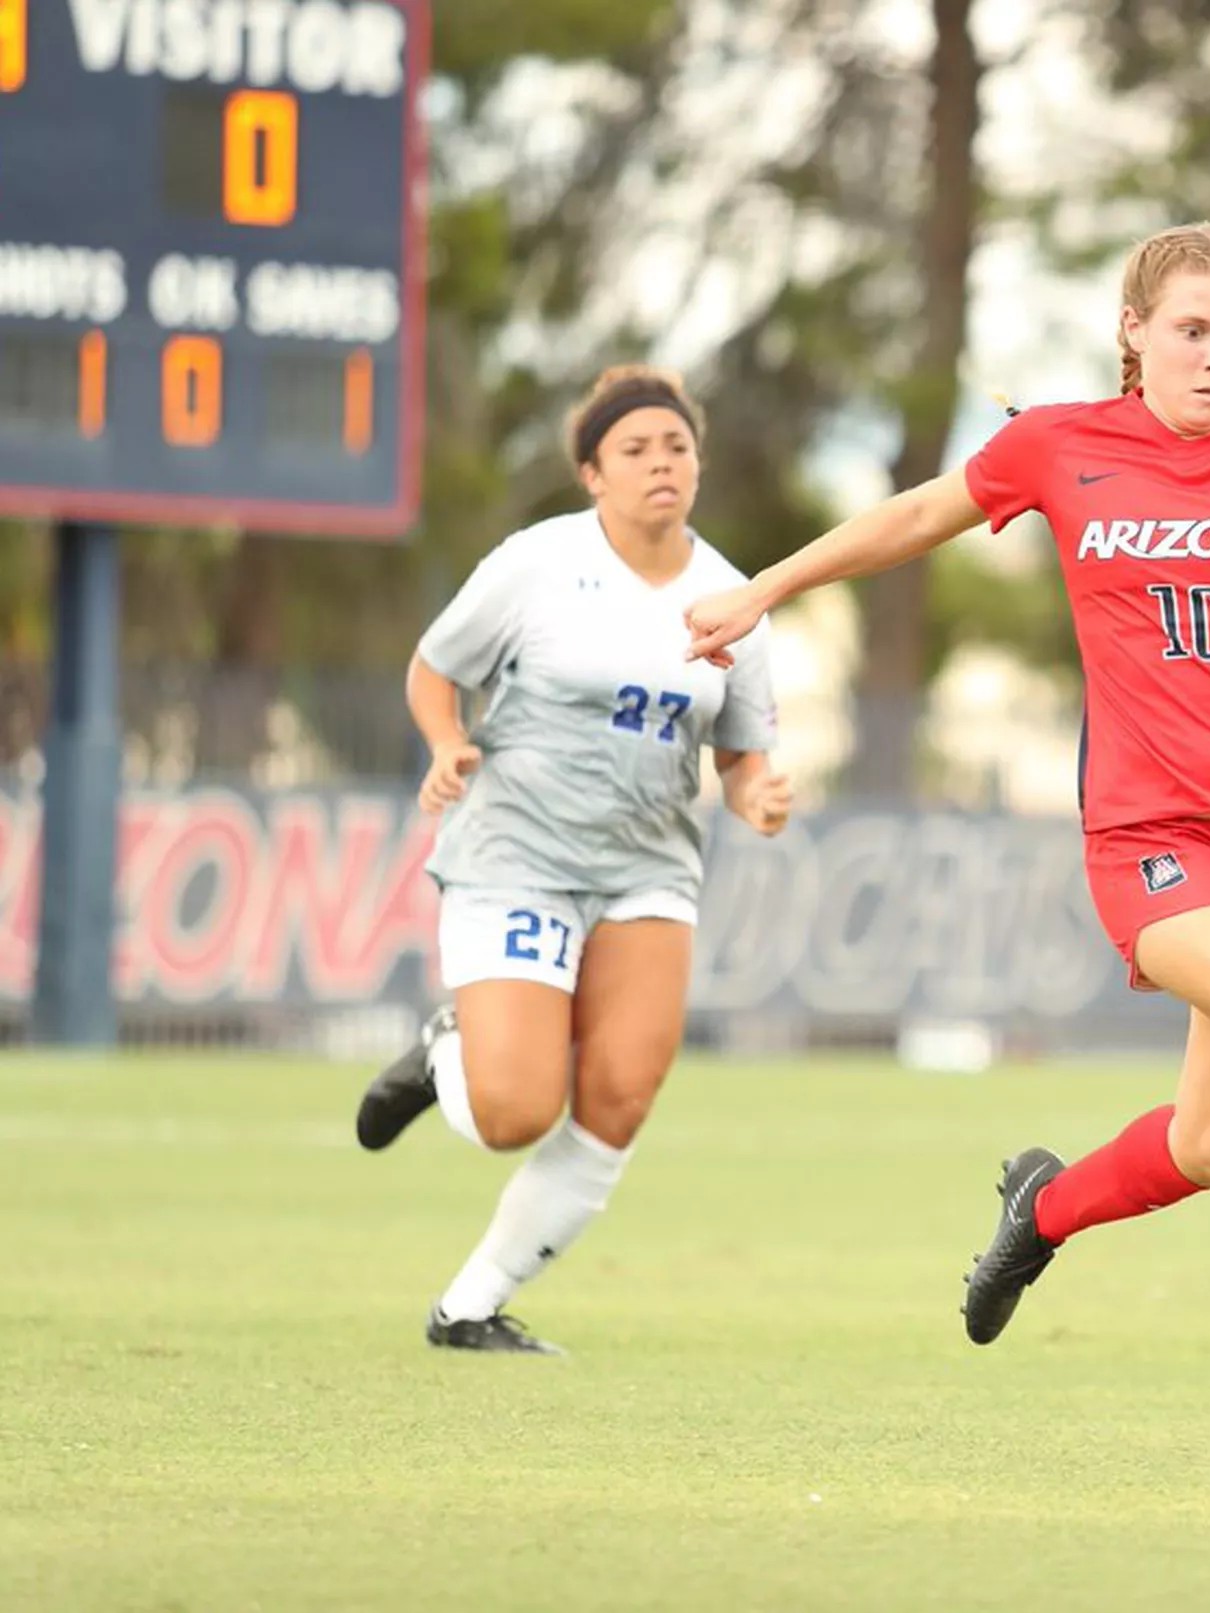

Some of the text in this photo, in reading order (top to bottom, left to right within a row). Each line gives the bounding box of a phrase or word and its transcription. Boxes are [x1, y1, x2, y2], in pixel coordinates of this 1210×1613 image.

[68, 0, 405, 98] VISITOR
[223, 88, 298, 226] 0
[162, 334, 223, 447] 0
[612, 684, 692, 743] 27
[505, 909, 573, 969] 27
